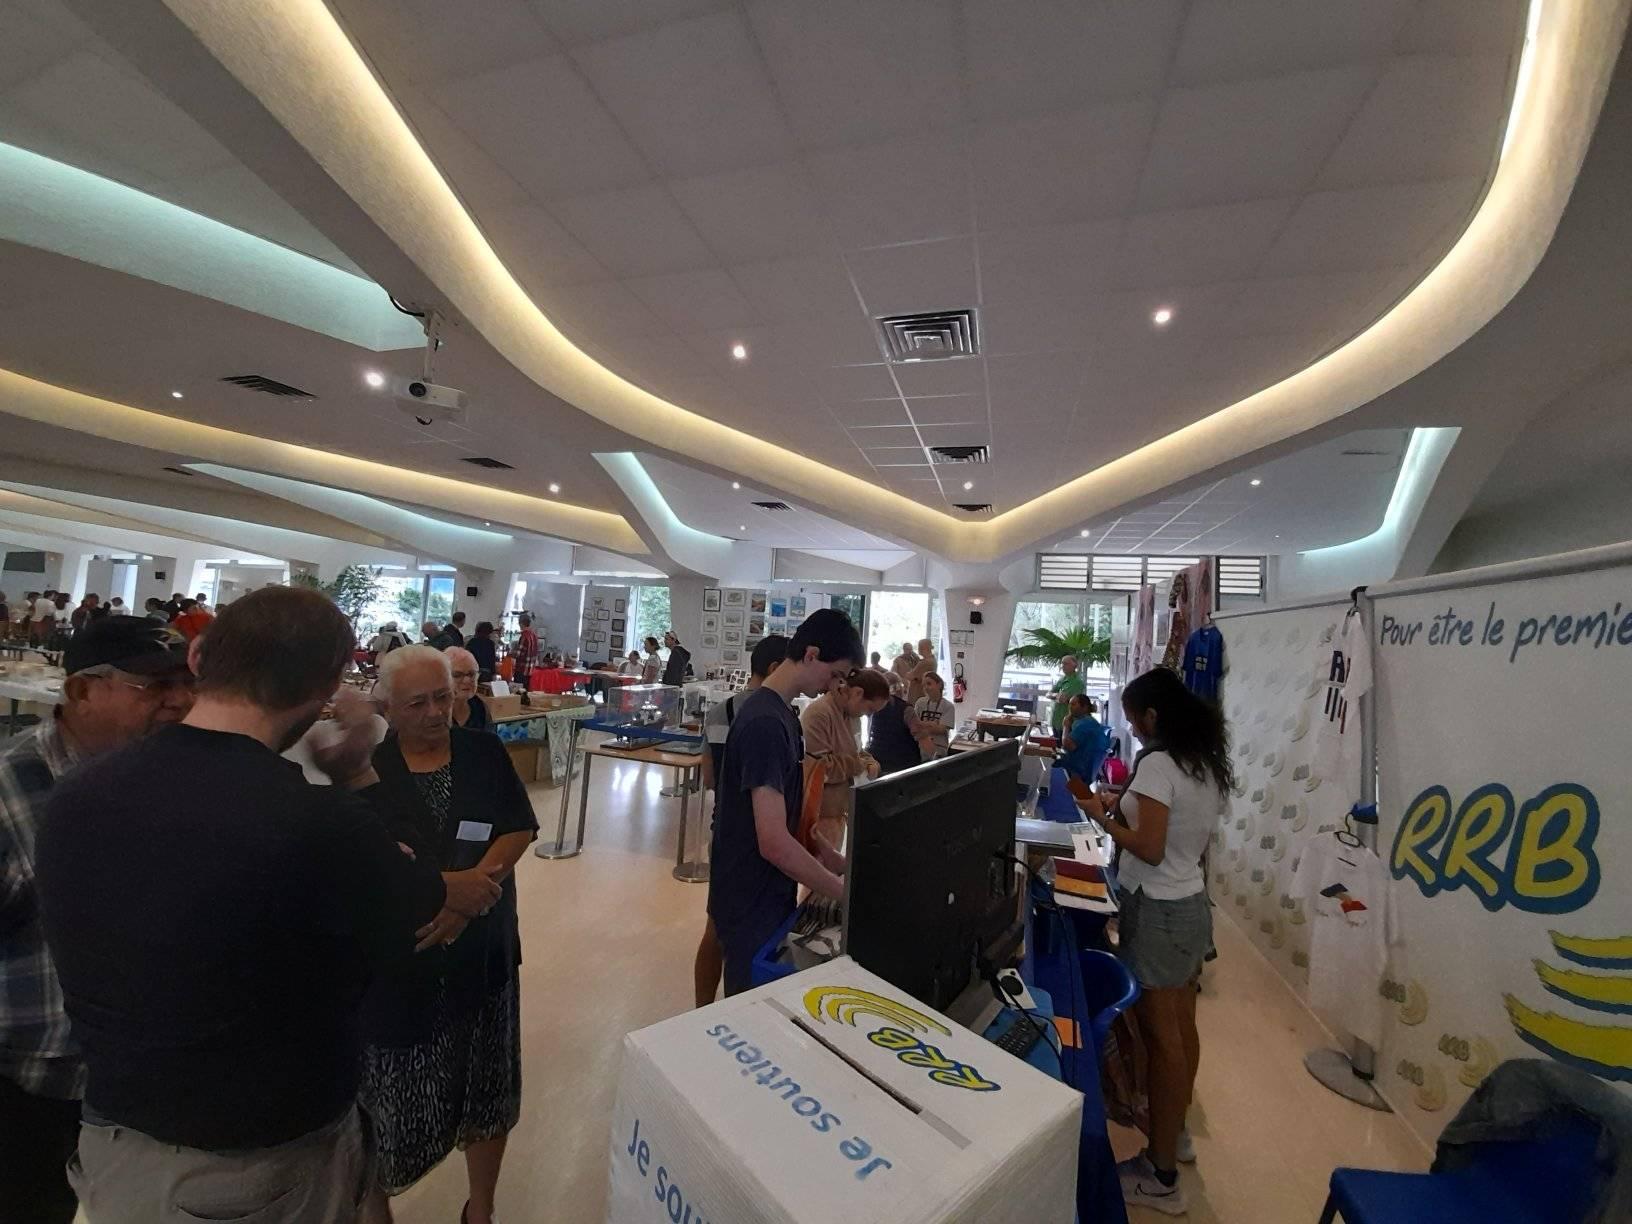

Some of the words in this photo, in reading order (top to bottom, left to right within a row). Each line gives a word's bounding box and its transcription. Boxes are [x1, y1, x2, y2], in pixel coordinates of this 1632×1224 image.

[1380, 614, 1423, 646] Pour
[1428, 606, 1474, 646] être
[1481, 601, 1505, 646] le
[1509, 601, 1632, 664] premie
[1389, 783, 1601, 915] RRB
[705, 1023, 842, 1133] soutiens
[866, 1026, 1002, 1092] RRB
[627, 1118, 650, 1177] Je
[838, 1136, 893, 1181] Je
